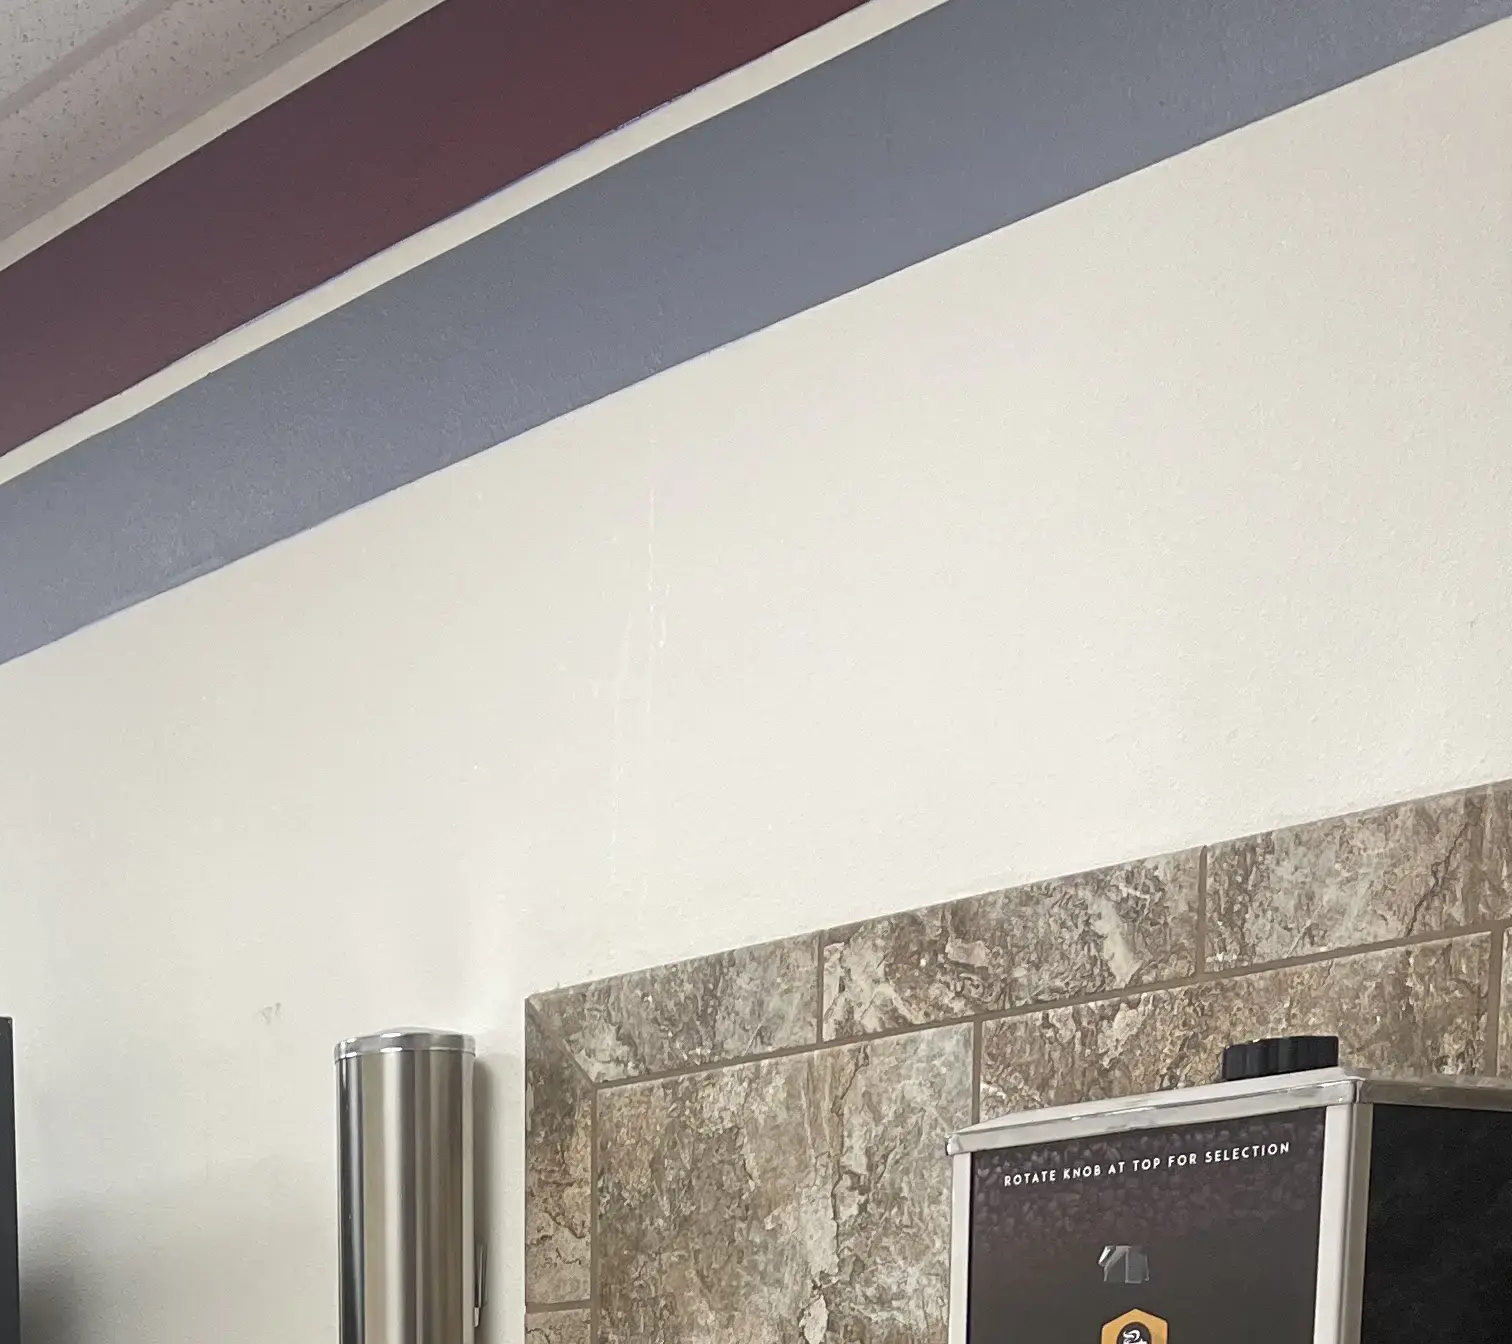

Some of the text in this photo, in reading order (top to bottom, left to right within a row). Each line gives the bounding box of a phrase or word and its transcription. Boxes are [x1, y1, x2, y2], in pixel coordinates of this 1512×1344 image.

[1003, 1141, 1290, 1187] ROTATE KNOB AT TOP FOR SELECTION
